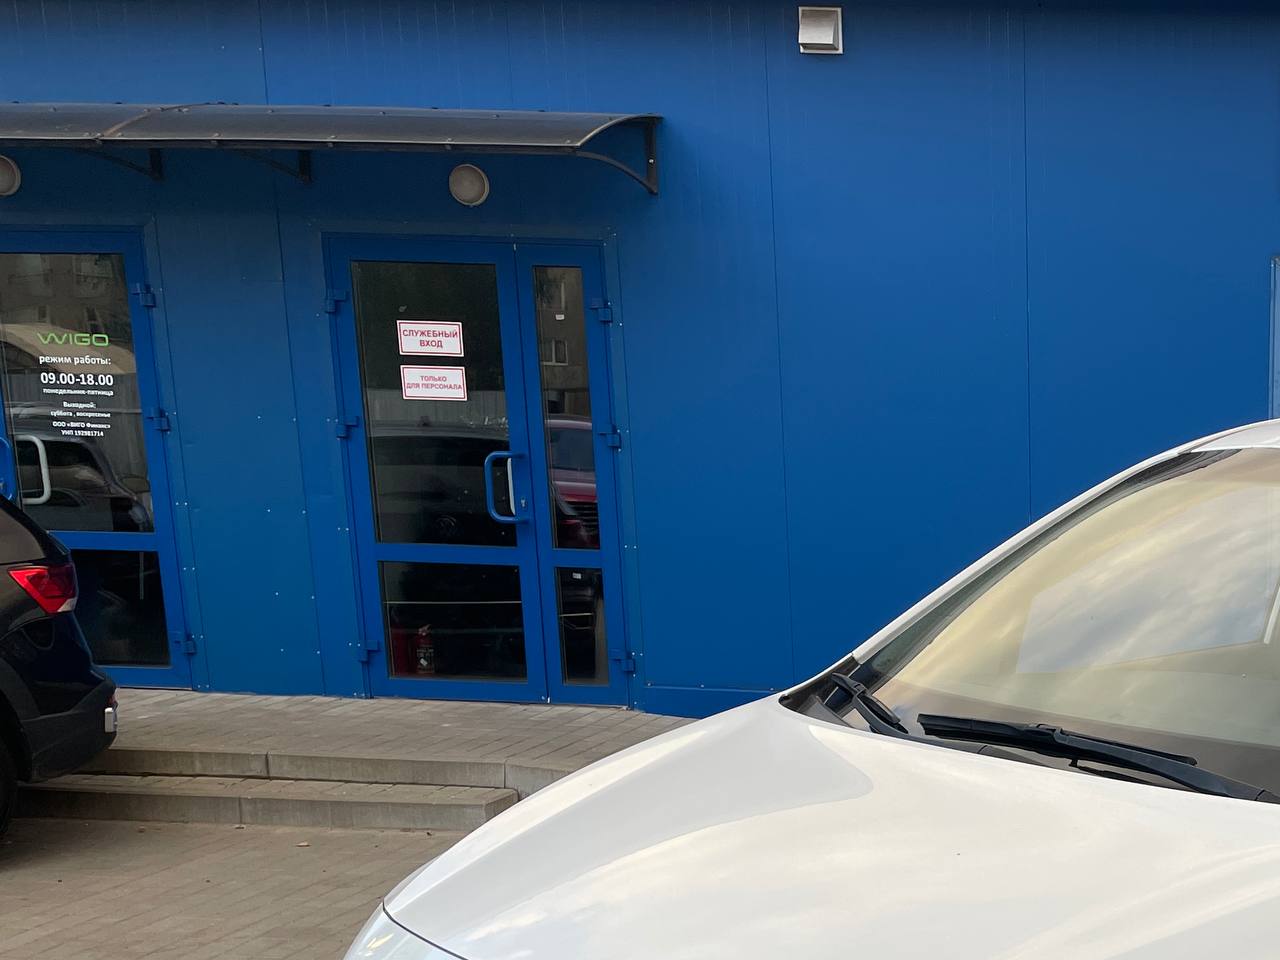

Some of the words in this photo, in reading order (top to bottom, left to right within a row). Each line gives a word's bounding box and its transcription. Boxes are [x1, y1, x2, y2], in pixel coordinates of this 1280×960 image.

[402, 329, 458, 338] СЛУЖЕБНЫЙ
[419, 340, 443, 348] ВХОД
[39, 355, 72, 365] режим
[73, 354, 112, 366] работы:
[40, 372, 114, 386] 09.00-18.00
